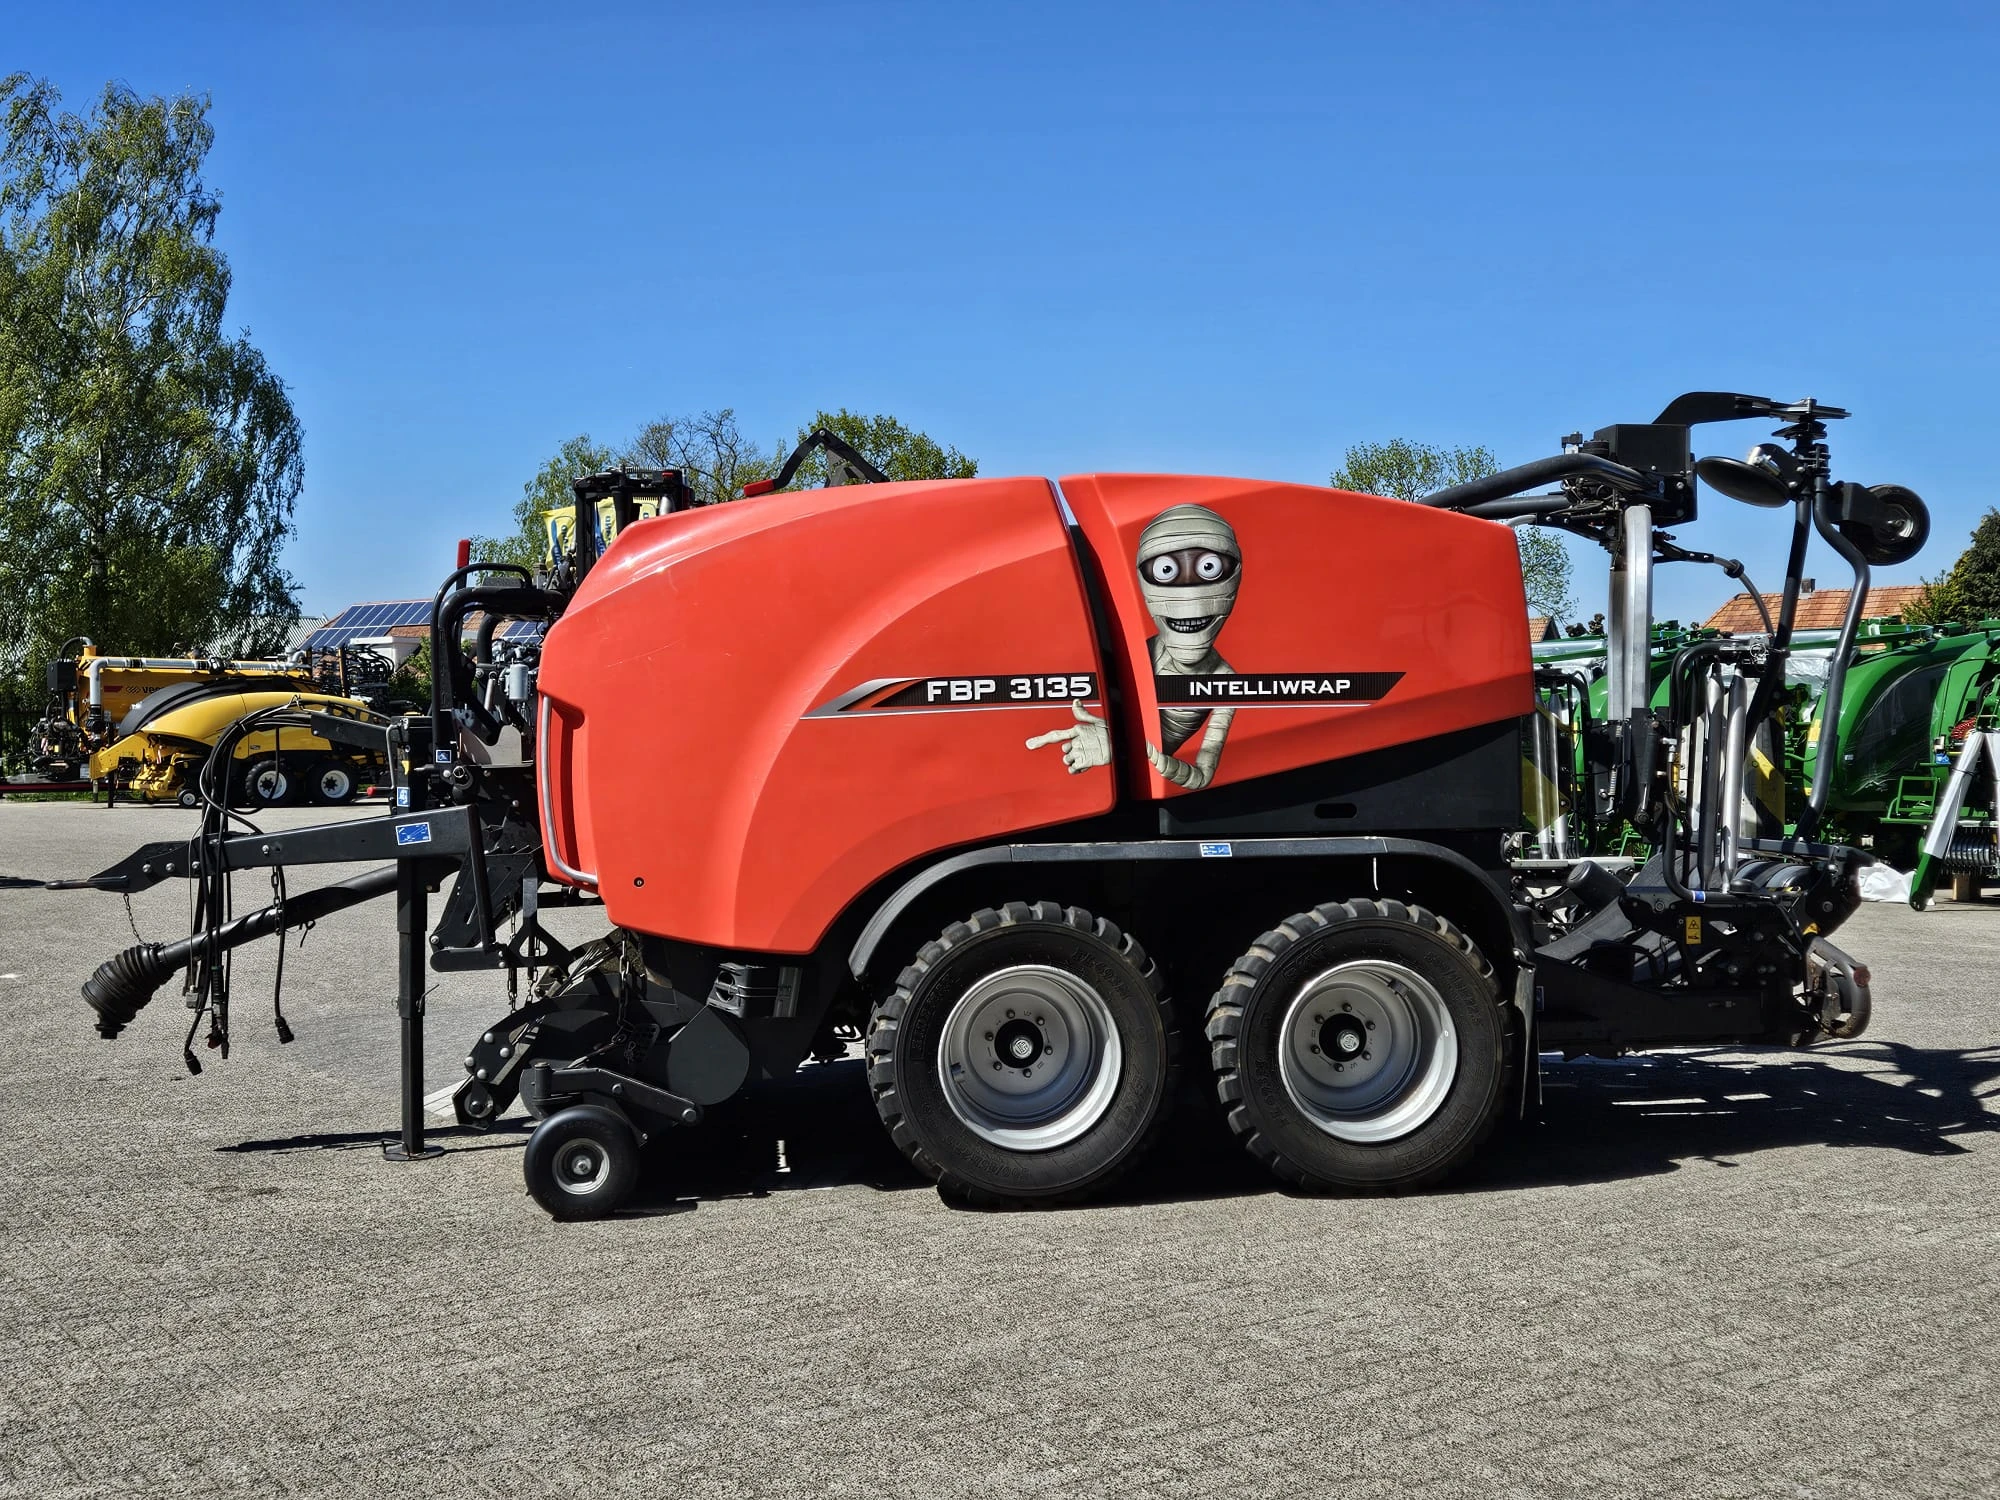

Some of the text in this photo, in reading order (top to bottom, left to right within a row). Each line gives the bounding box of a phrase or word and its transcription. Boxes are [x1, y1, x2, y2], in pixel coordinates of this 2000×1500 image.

[927, 677, 1092, 702] FBP 3135
[1190, 680, 1351, 695] INTELLIWRAP
